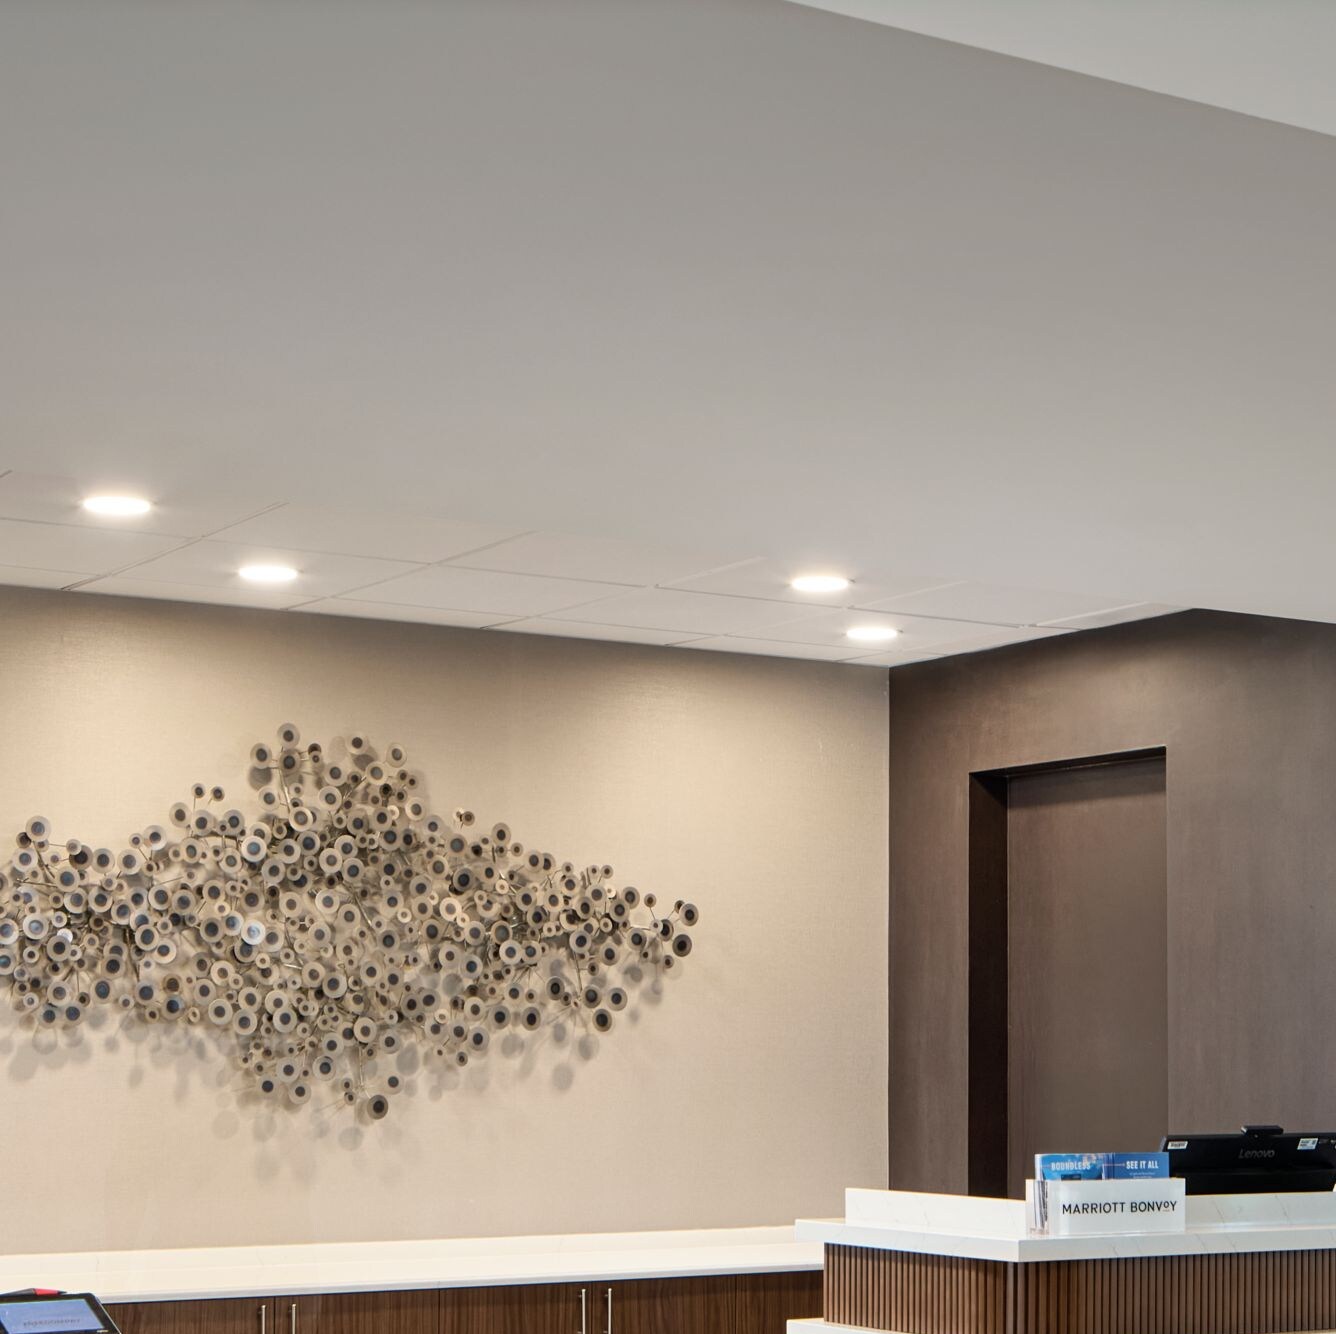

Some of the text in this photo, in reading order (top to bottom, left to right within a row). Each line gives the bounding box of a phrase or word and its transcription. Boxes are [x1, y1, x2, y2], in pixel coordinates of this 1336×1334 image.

[1238, 1149, 1276, 1159] Lenovo
[1051, 1161, 1091, 1171] BOUNDLESS
[1126, 1160, 1159, 1170] SEE IT ALL
[1062, 1202, 1126, 1215] MARRIOTT
